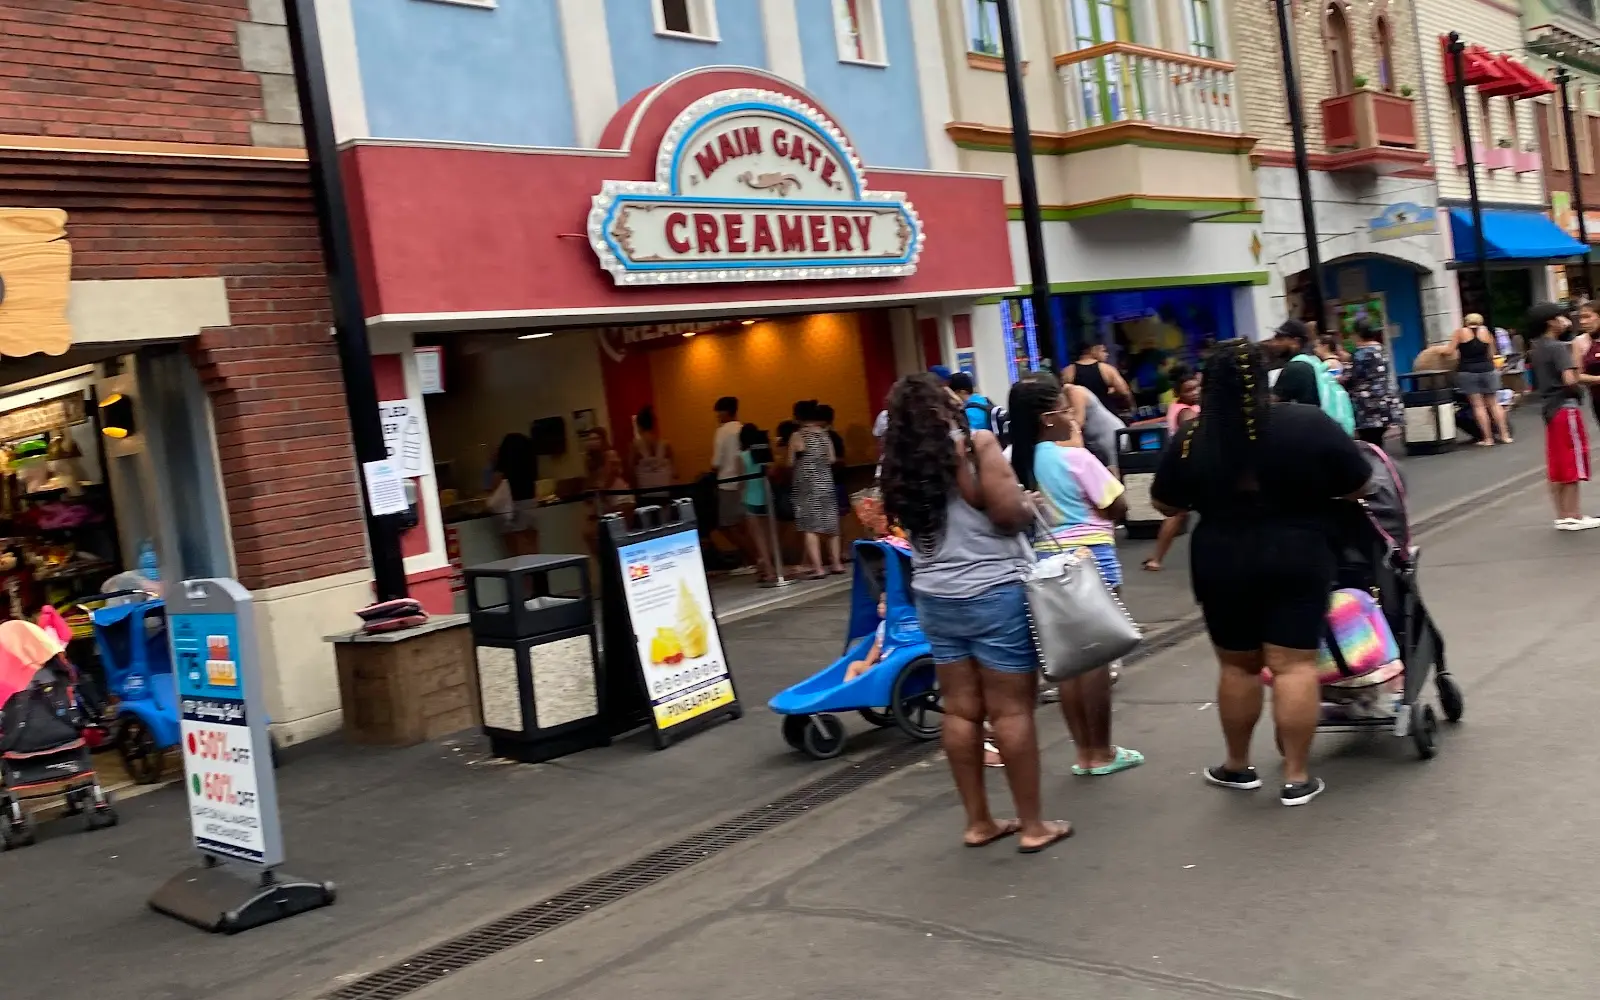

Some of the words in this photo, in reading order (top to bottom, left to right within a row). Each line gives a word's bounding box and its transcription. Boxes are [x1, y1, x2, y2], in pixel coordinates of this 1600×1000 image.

[694, 125, 762, 179] MAIN
[771, 128, 839, 187] GATE
[664, 211, 874, 255] CREAMERY
